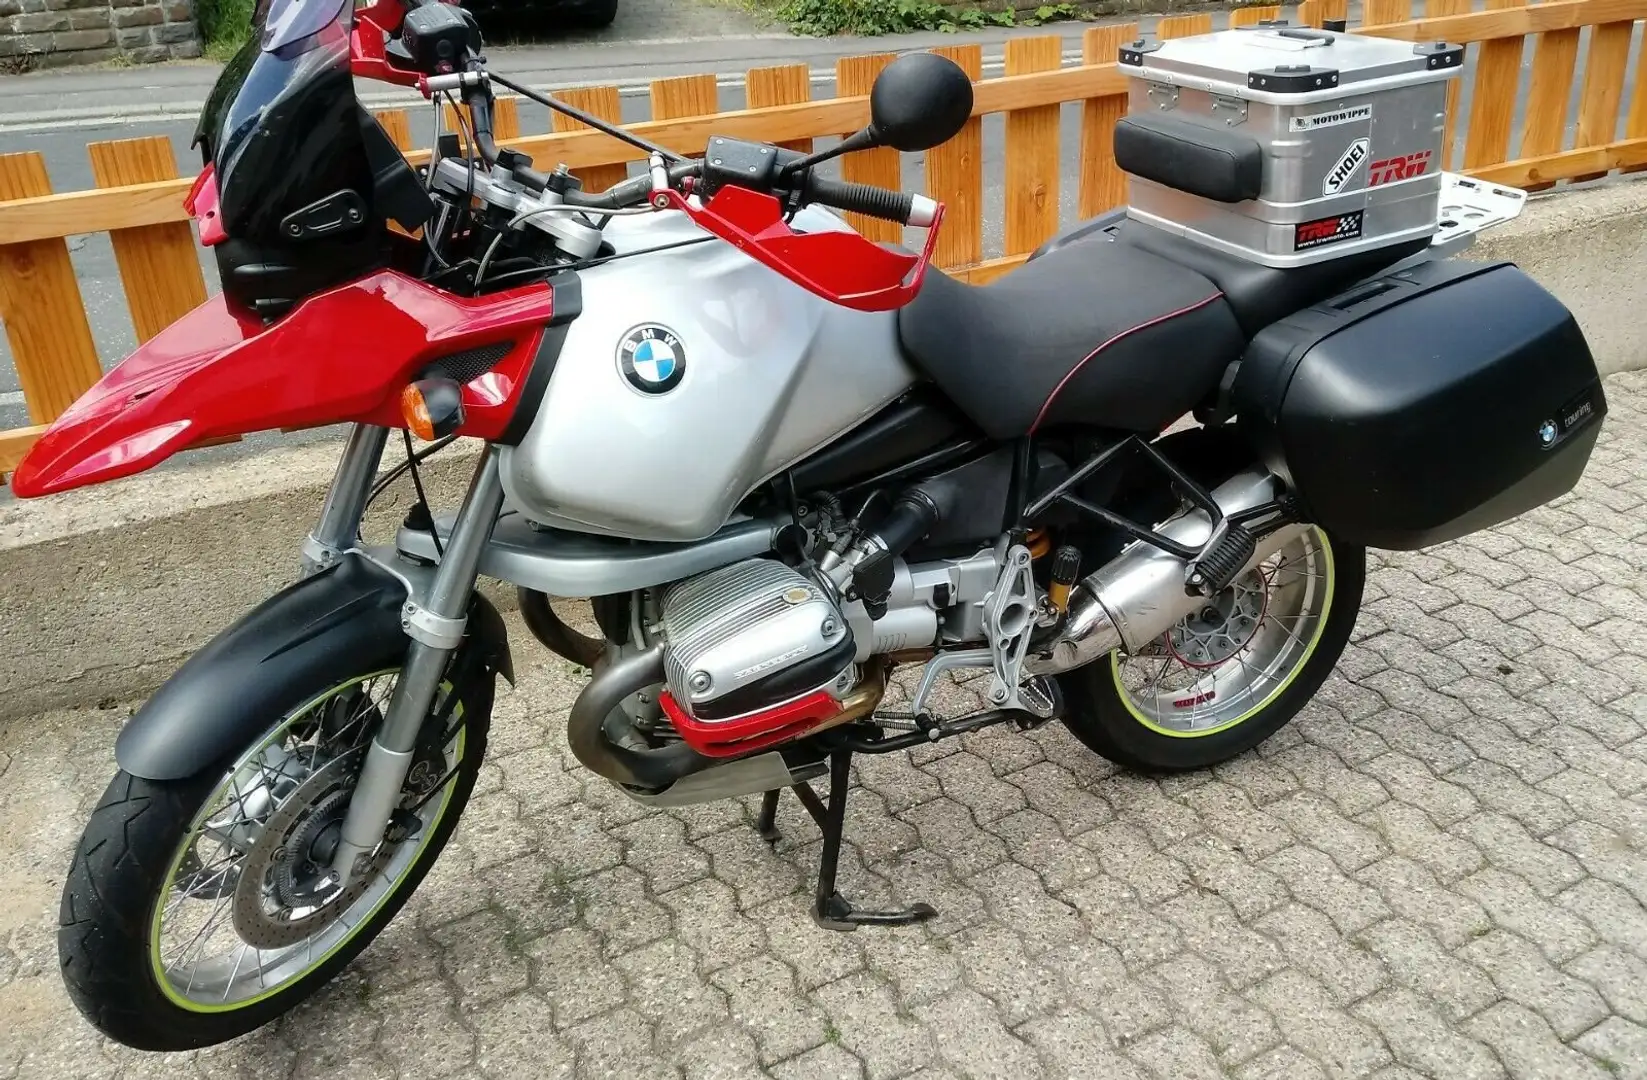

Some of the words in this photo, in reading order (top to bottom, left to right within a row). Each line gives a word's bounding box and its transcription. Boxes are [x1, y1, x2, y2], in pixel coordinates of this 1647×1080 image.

[1312, 107, 1371, 126] MOTOWIPPE
[1328, 144, 1365, 190] SHOEI
[1368, 150, 1432, 188] TRW
[1297, 230, 1360, 248] www.trwmoto.com
[1298, 217, 1340, 242] TRW
[623, 328, 678, 353] BMW
[1564, 401, 1591, 428] touring
